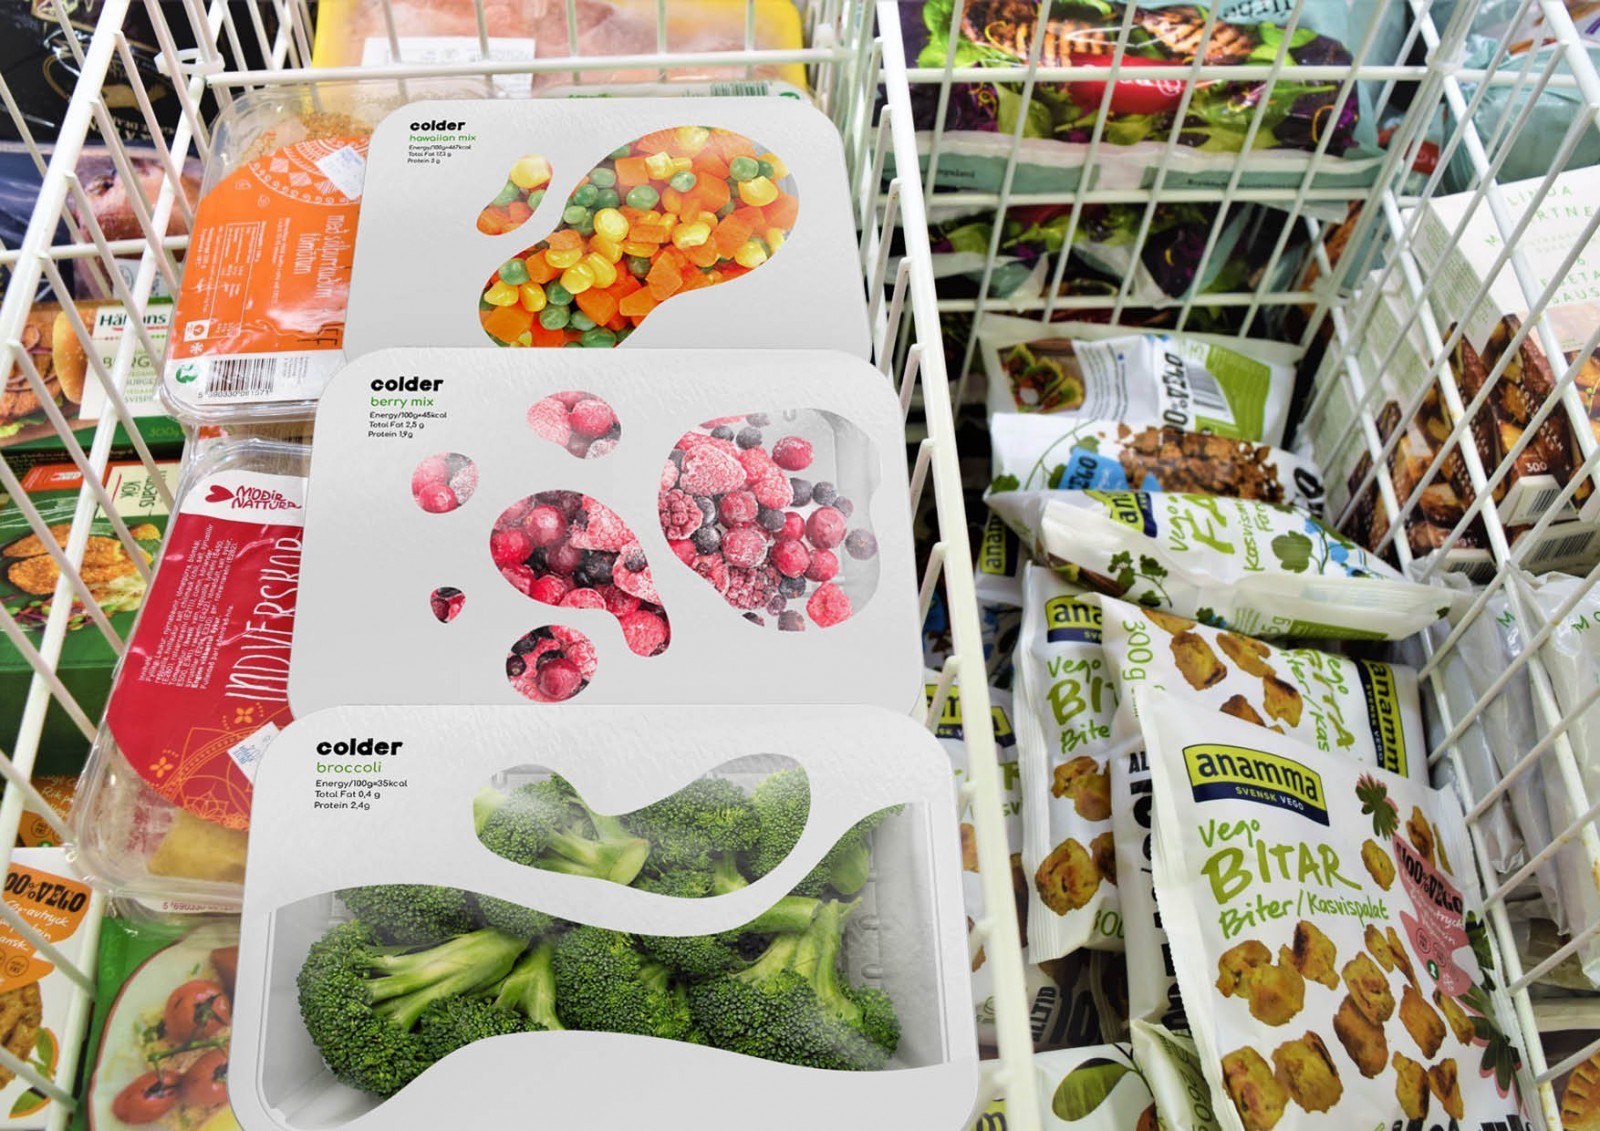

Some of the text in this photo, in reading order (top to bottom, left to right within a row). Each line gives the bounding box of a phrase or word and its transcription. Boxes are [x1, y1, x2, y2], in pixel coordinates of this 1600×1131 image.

[410, 120, 466, 131] colder
[409, 134, 477, 142] hawaiian mix
[370, 376, 444, 392] colder
[1162, 352, 1190, 434] 00%VEGO
[370, 396, 434, 409] berry mix
[405, 421, 418, 429] 2,5
[1122, 620, 1154, 663] 300
[1047, 656, 1102, 684] Vego
[1369, 663, 1400, 774] anamm
[316, 738, 404, 756] colder
[1060, 719, 1110, 754] Bite
[316, 761, 382, 773] broccoli
[1195, 753, 1319, 801] anamma
[315, 779, 408, 789] Energy/100g=35kcal
[315, 790, 381, 799] Total Fat 0,4 g
[314, 801, 371, 811] Protein 2,4g
[1235, 786, 1305, 811] SVENSK VEGO
[1198, 818, 1260, 848] Vego
[1200, 838, 1363, 905] BITAR
[3, 872, 87, 913] 00%VEGO
